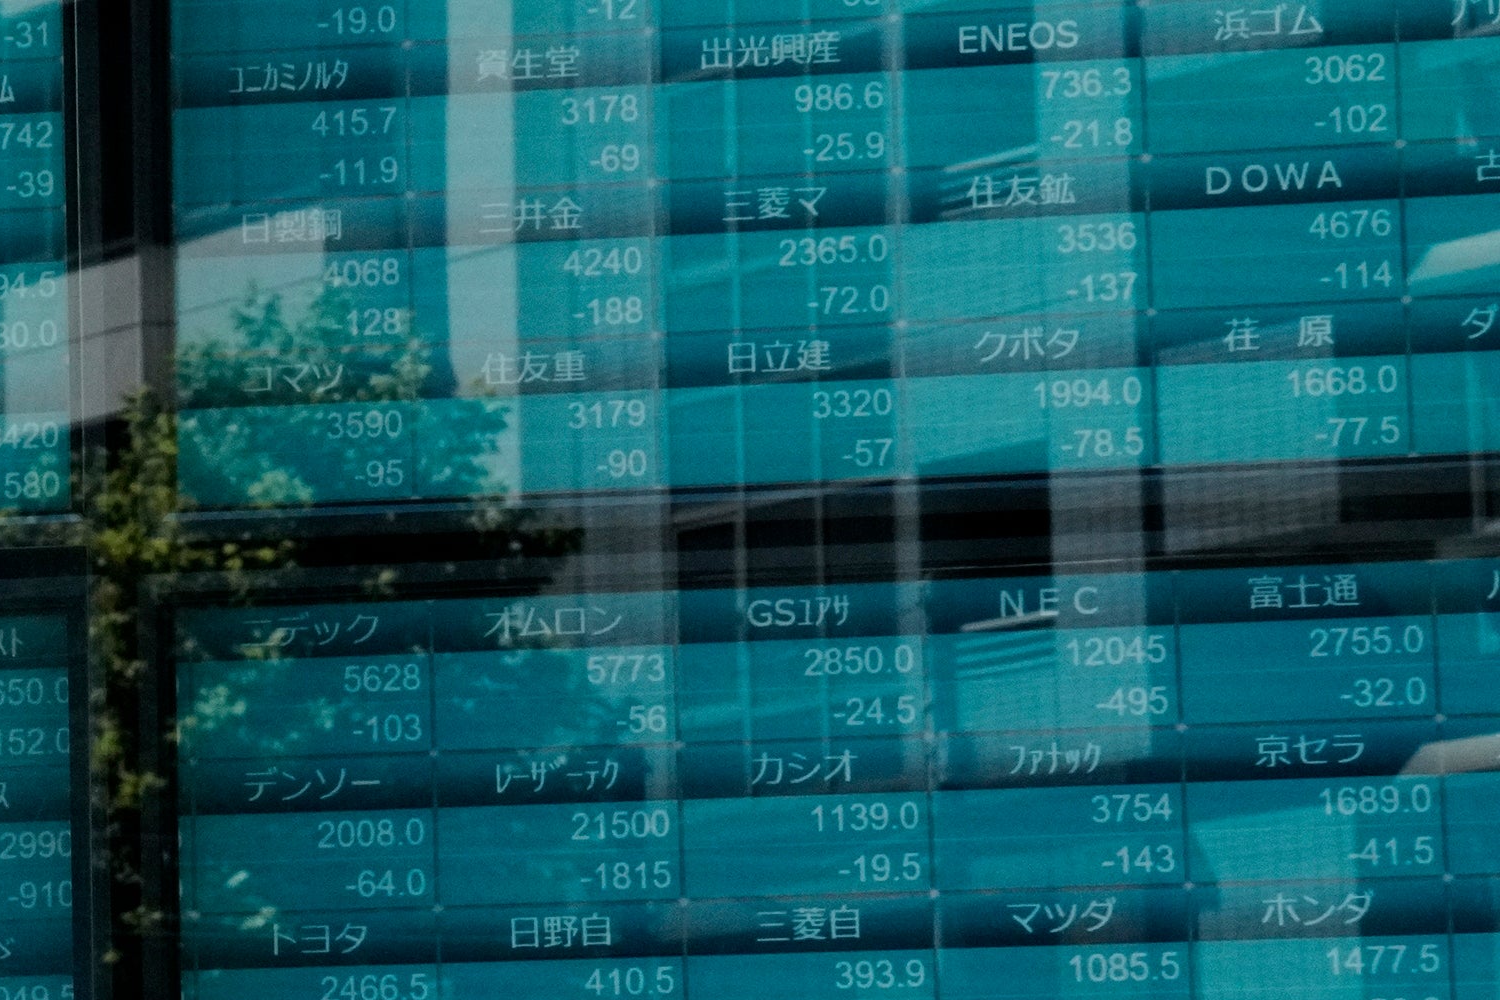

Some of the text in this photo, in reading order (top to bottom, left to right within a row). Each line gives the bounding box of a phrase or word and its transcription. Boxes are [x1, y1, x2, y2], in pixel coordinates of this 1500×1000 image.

[959, 21, 1079, 54] ENEOS
[1214, 9, 1323, 42] 浜ゴム
[476, 47, 580, 80] 資生堂
[701, 29, 842, 70] 出光興産
[1305, 54, 1386, 84] 3062
[312, 108, 396, 136] 415.7
[561, 96, 638, 124] 3178
[967, 174, 1074, 207] 住友鉱
[1206, 161, 1341, 195] DOWA
[479, 198, 582, 233] 三井金
[723, 187, 826, 221] 三菱マ
[1310, 210, 1390, 238] 4676
[564, 248, 641, 275] 4240
[1321, 261, 1392, 289] -114
[727, 339, 831, 374] 日立建
[975, 328, 1079, 362] クボタ
[481, 351, 586, 384] 住友重
[1287, 365, 1397, 397] 1668.0
[568, 402, 645, 429] 3179
[812, 389, 891, 417] 3320
[1248, 575, 1359, 609] 富士通
[485, 606, 621, 639] オムロン
[1309, 626, 1423, 656] 2755.0
[343, 664, 420, 691] 5628
[1255, 734, 1363, 767] 京セラ
[245, 768, 380, 799] デンソー
[752, 750, 857, 786] カシオ
[811, 801, 918, 831] 1139.0
[1091, 794, 1172, 822] 3754
[317, 819, 424, 848] 2008.0
[756, 906, 860, 942] 三菱自
[1009, 898, 1116, 933] マツダ
[1262, 891, 1372, 925] ホンダ
[273, 924, 368, 955] トヨタ
[511, 914, 612, 948] 日野自
[836, 960, 925, 988] 393.9
[1070, 951, 1179, 982] 1085.5
[1325, 945, 1439, 974] 1477.5
[585, 967, 674, 995] 410.5
